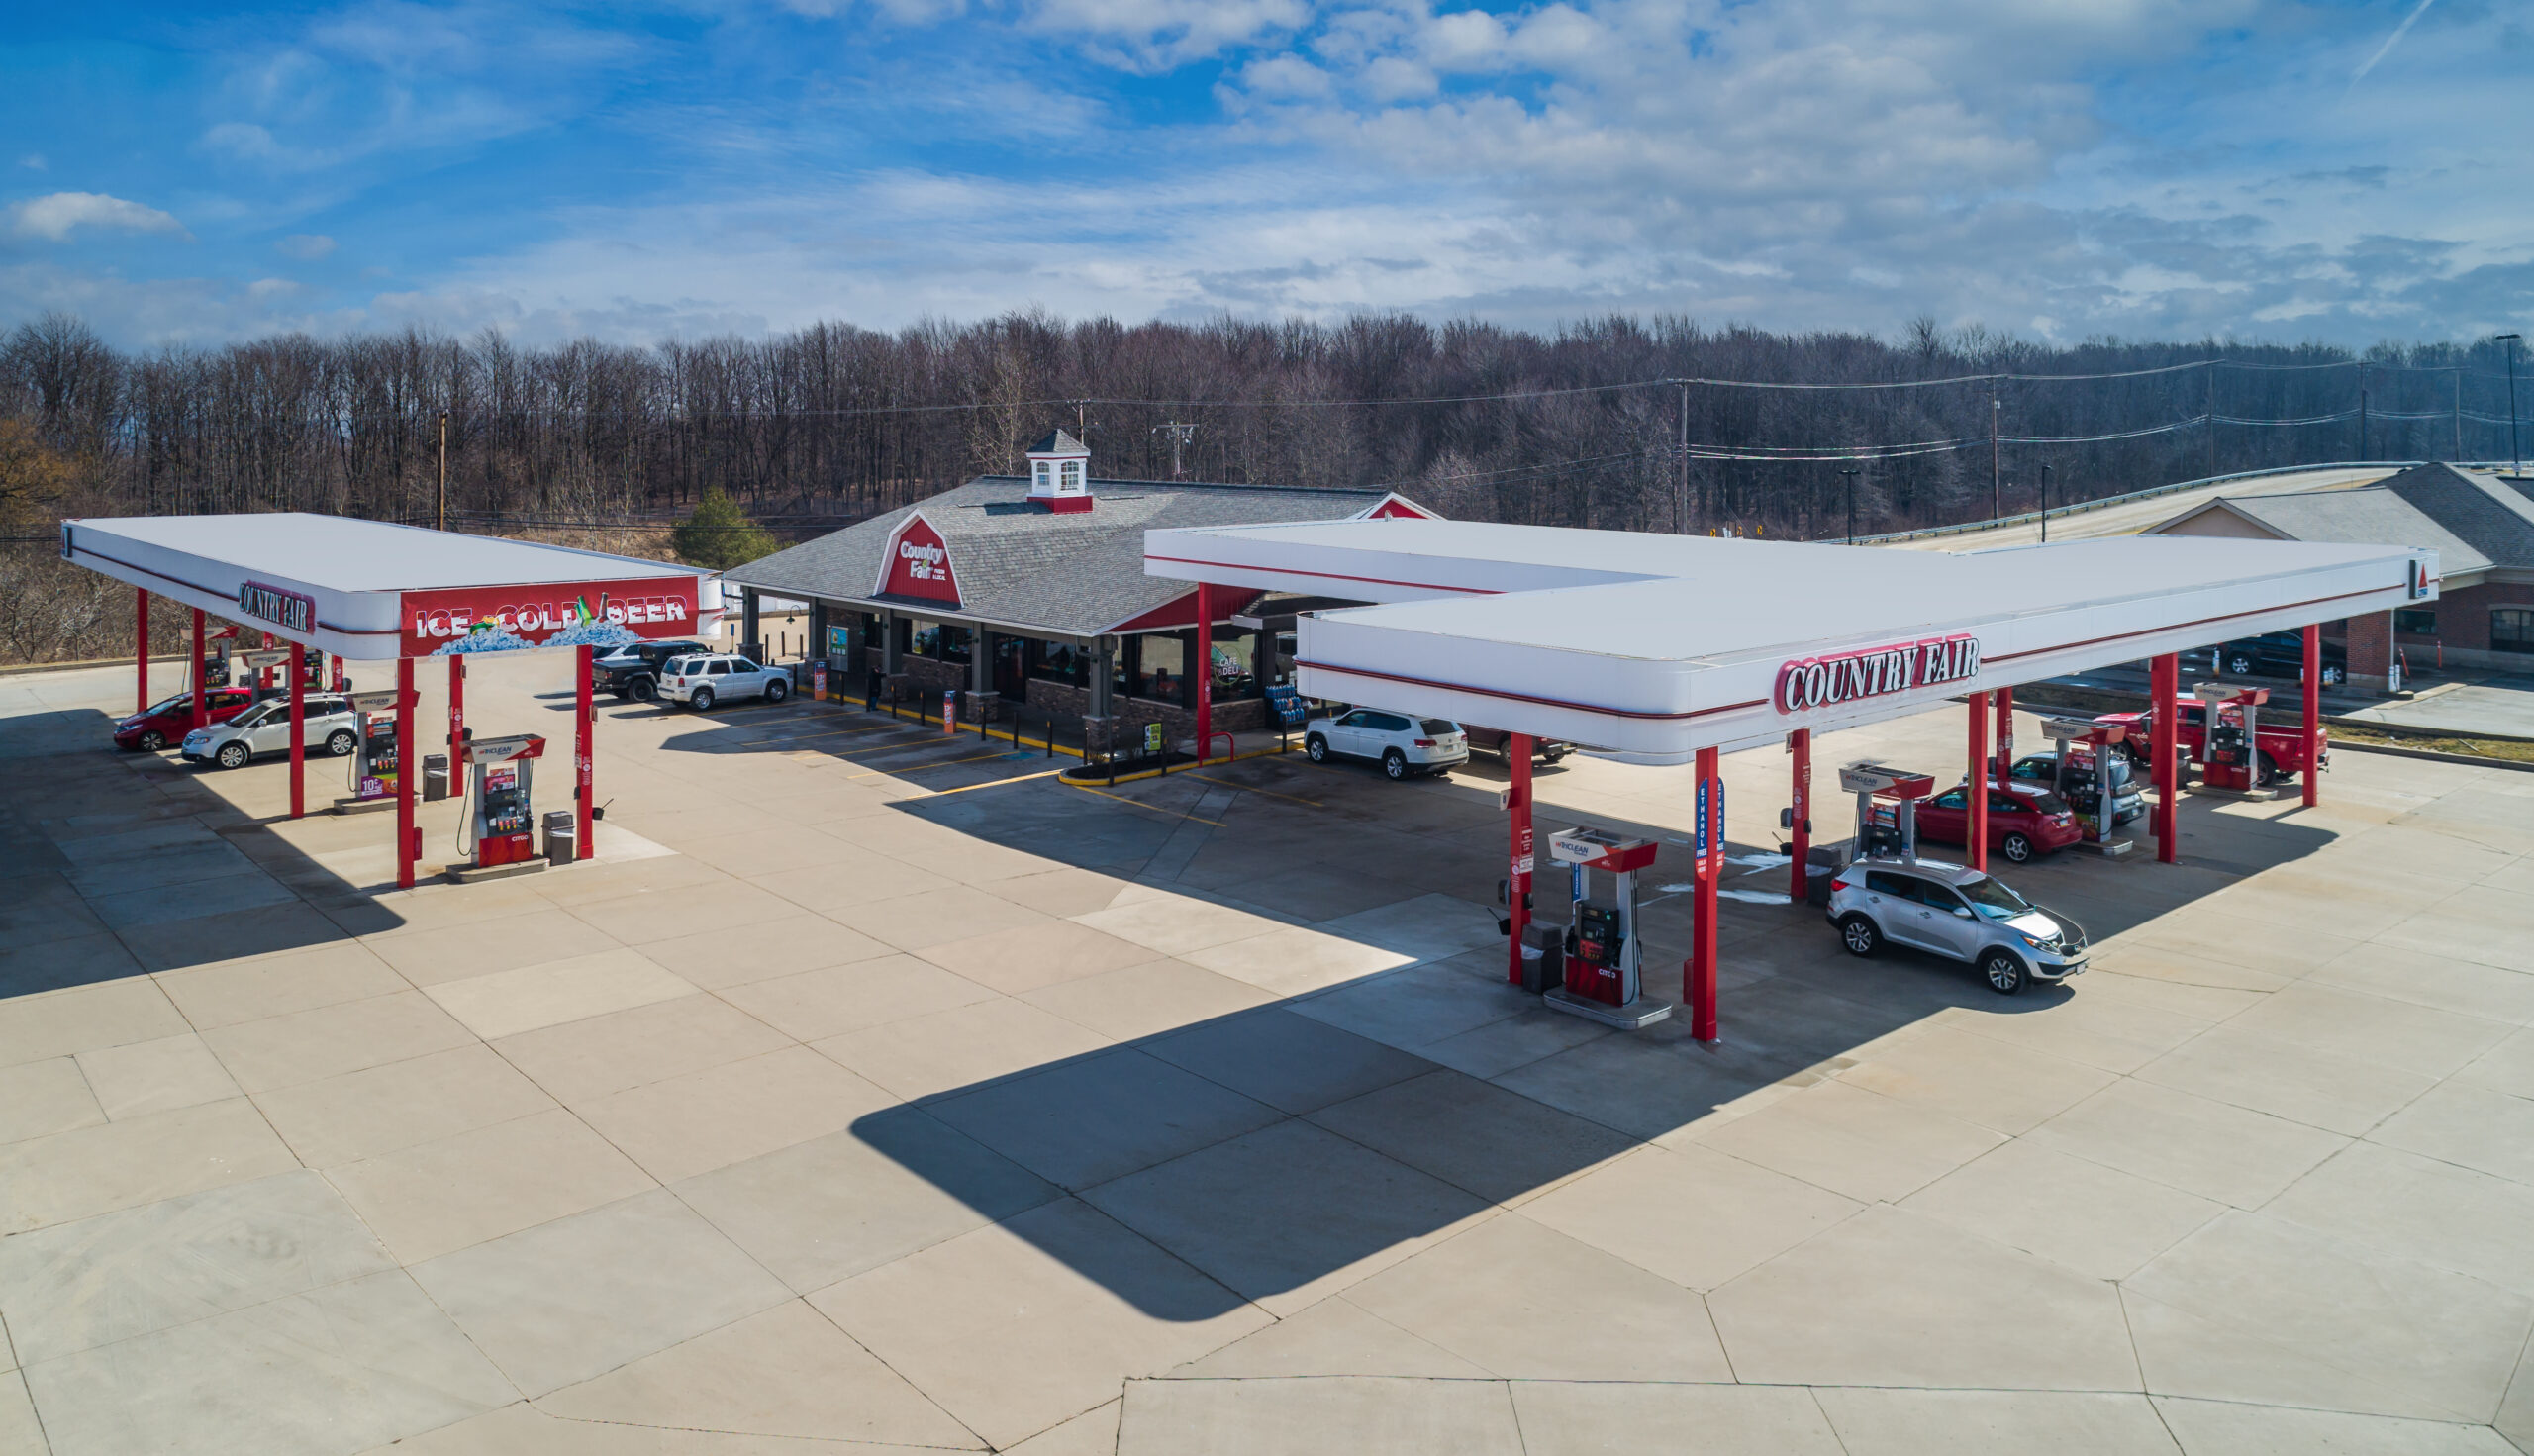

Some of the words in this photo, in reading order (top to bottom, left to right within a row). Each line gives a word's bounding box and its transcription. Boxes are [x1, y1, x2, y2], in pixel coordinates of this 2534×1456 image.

[901, 540, 945, 565] Country
[910, 560, 933, 579] Fair
[239, 582, 282, 623] COUNTRY
[283, 595, 308, 632] FAIR
[416, 607, 473, 638] ICE
[495, 601, 580, 631] COLD
[606, 595, 687, 625] BEER
[1219, 656, 1238, 667] CAFE
[1222, 666, 1239, 675] DELI
[1785, 646, 1920, 712] COUNTRY
[1921, 637, 1980, 685] FAIR
